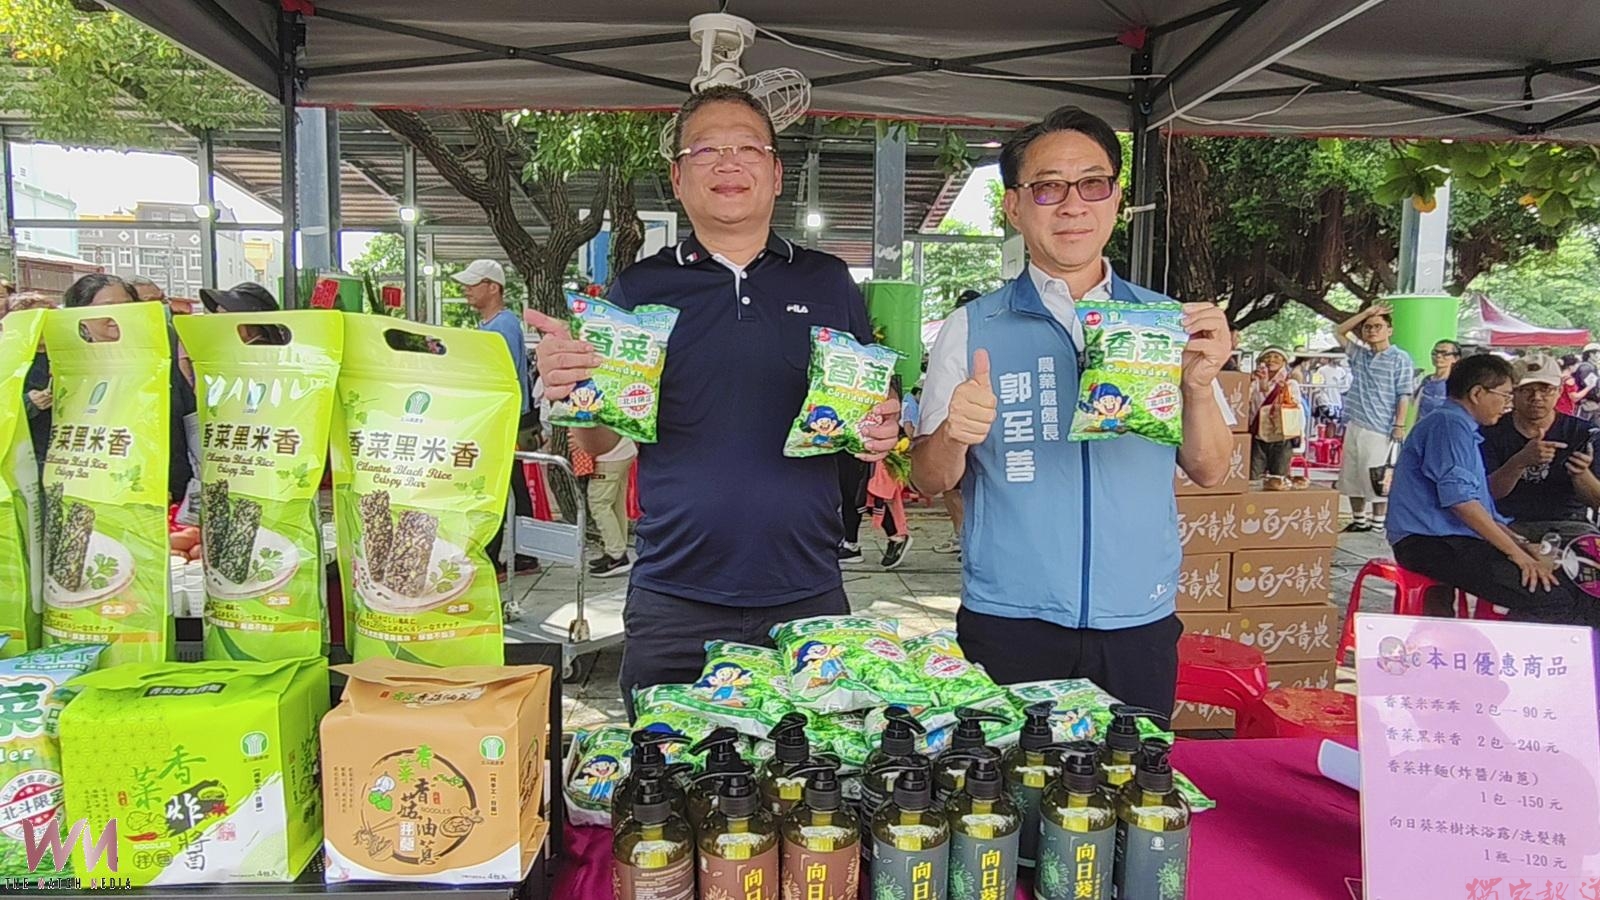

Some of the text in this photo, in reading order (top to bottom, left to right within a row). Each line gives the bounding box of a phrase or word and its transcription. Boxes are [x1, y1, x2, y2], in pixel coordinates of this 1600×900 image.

[786, 304, 809, 314] FILA
[1104, 329, 1172, 361] 香菜
[826, 352, 889, 394] 香菜
[999, 371, 1036, 482] 郭至善
[356, 461, 453, 480] Cilantro Black Rice
[373, 473, 426, 488] Crispy Bar
[1262, 500, 1334, 541] 百大青農
[1257, 556, 1326, 599] 百大青農
[1256, 614, 1332, 654] 百大青農
[1426, 647, 1568, 679] 本日優惠商品
[1386, 727, 1462, 746] 香菜黑米香
[1074, 843, 1096, 899] 向日葵
